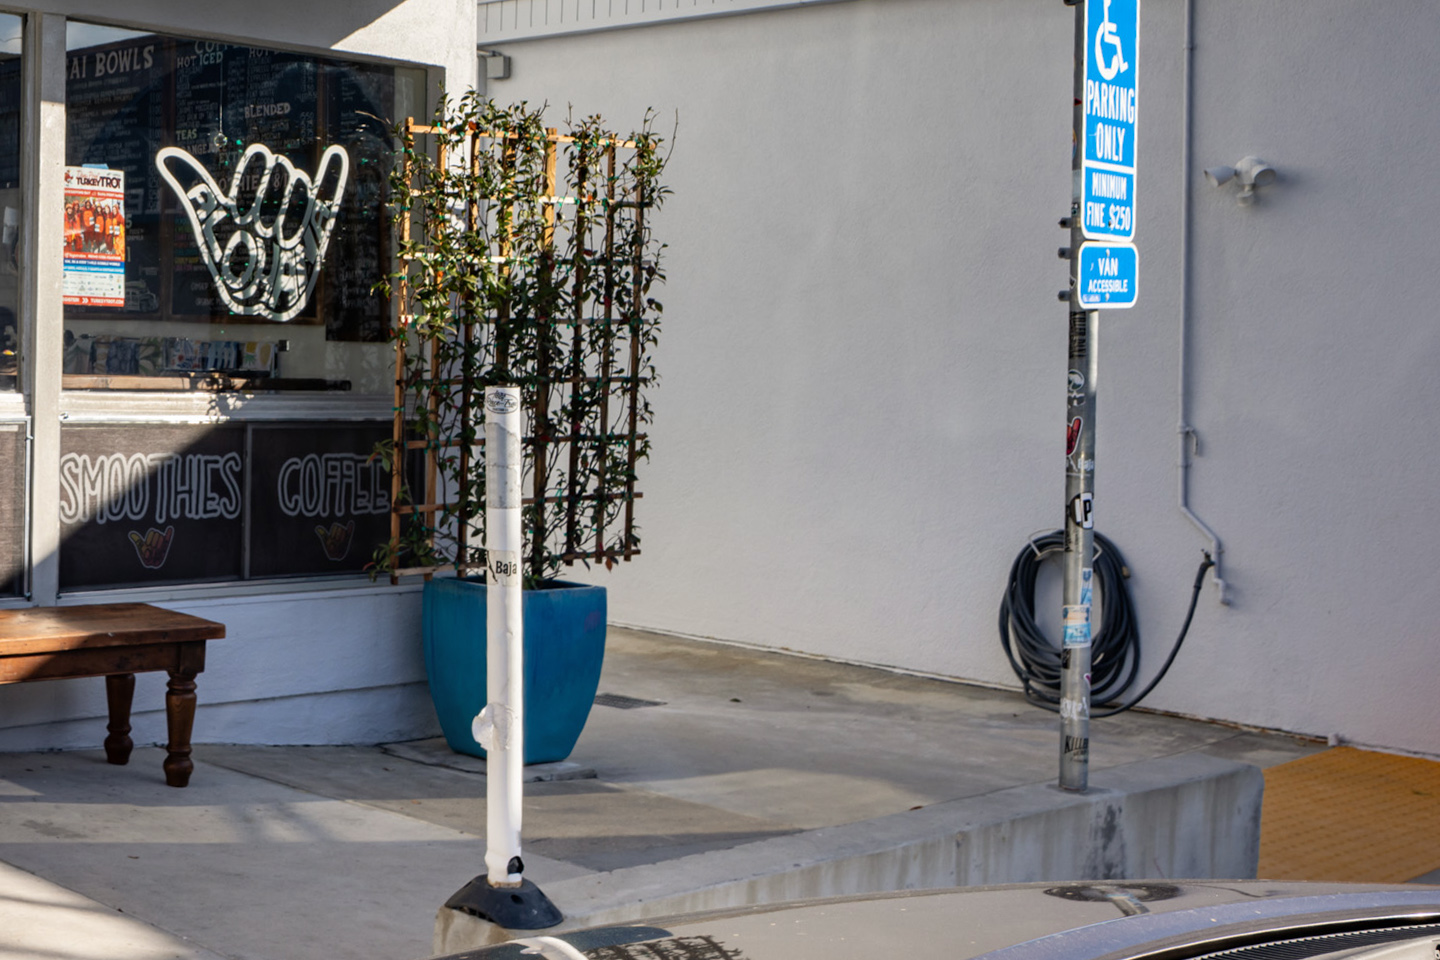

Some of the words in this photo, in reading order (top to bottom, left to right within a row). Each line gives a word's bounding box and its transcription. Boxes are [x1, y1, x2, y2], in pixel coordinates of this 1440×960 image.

[94, 45, 155, 78] BOWLS
[176, 55, 197, 69] HOT
[199, 51, 224, 66] ICED
[244, 102, 291, 119] BLENDED
[1086, 79, 1135, 124] PARKING
[176, 128, 198, 141] TEAS
[1096, 122, 1126, 162] ONLY
[1092, 171, 1127, 200] MINIMUM
[1086, 202, 1105, 228] FINE
[1109, 203, 1131, 231] $250
[1098, 257, 1119, 276] VAN
[1088, 279, 1128, 293] ACCESSIBLE
[60, 451, 242, 525] SMOOTHIES
[278, 452, 391, 518] COFFEE
[496, 560, 518, 577] Baja
